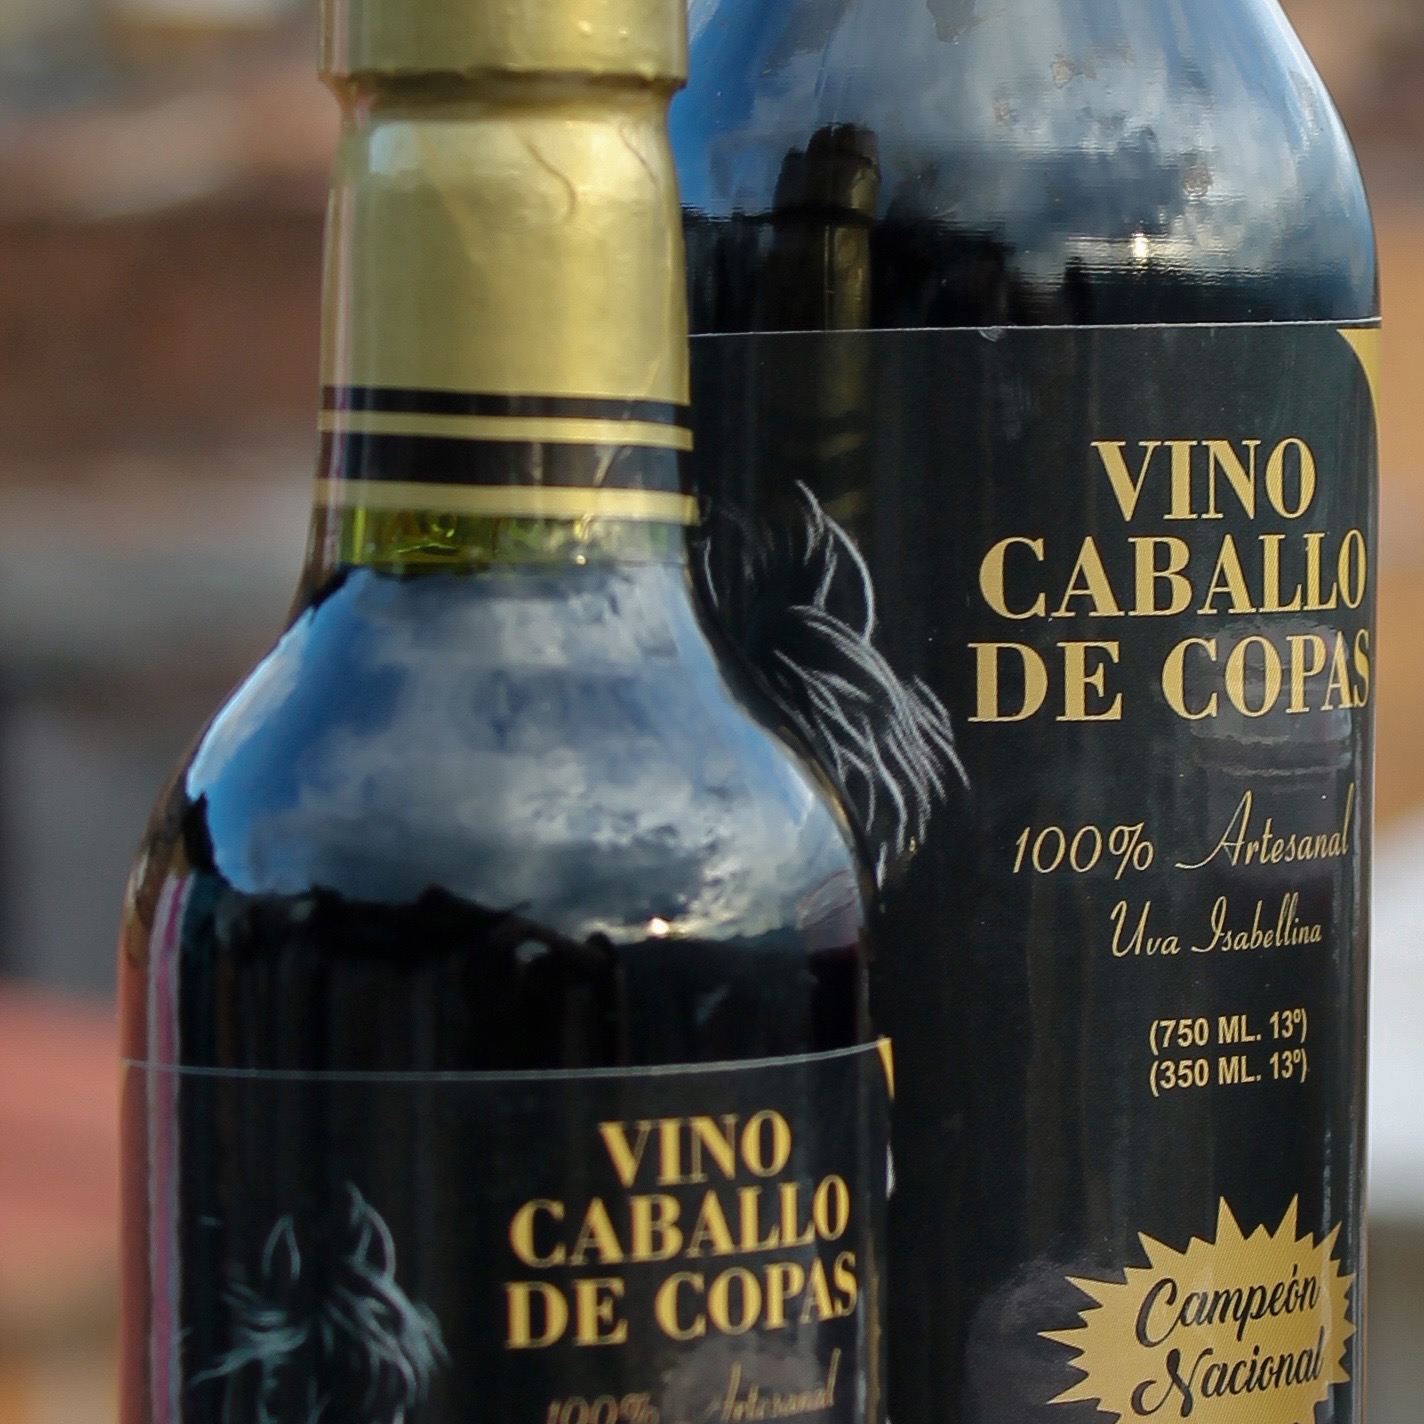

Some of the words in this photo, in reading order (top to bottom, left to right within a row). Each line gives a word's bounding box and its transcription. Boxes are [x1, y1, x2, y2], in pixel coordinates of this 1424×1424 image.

[1091, 437, 1316, 522] VINO
[979, 529, 1367, 619] CABALLO
[968, 640, 1122, 722] DE
[1161, 627, 1370, 719] COPAS
[1013, 822, 1155, 880] 100%
[1175, 782, 1355, 869] Artesanal
[1110, 900, 1181, 957] Uva
[1191, 891, 1322, 953] Isabellina
[1149, 1018, 1209, 1056] (750
[1217, 1014, 1262, 1044] ML.
[1150, 1059, 1209, 1097] (350
[1218, 1055, 1261, 1085] ML.
[598, 1109, 792, 1188] VINO
[509, 1175, 850, 1269] CABALLO
[505, 1277, 628, 1349] DE
[654, 1251, 857, 1341] COPAS
[1135, 1263, 1320, 1347] Campeón
[1131, 1326, 1325, 1417] Nacional
